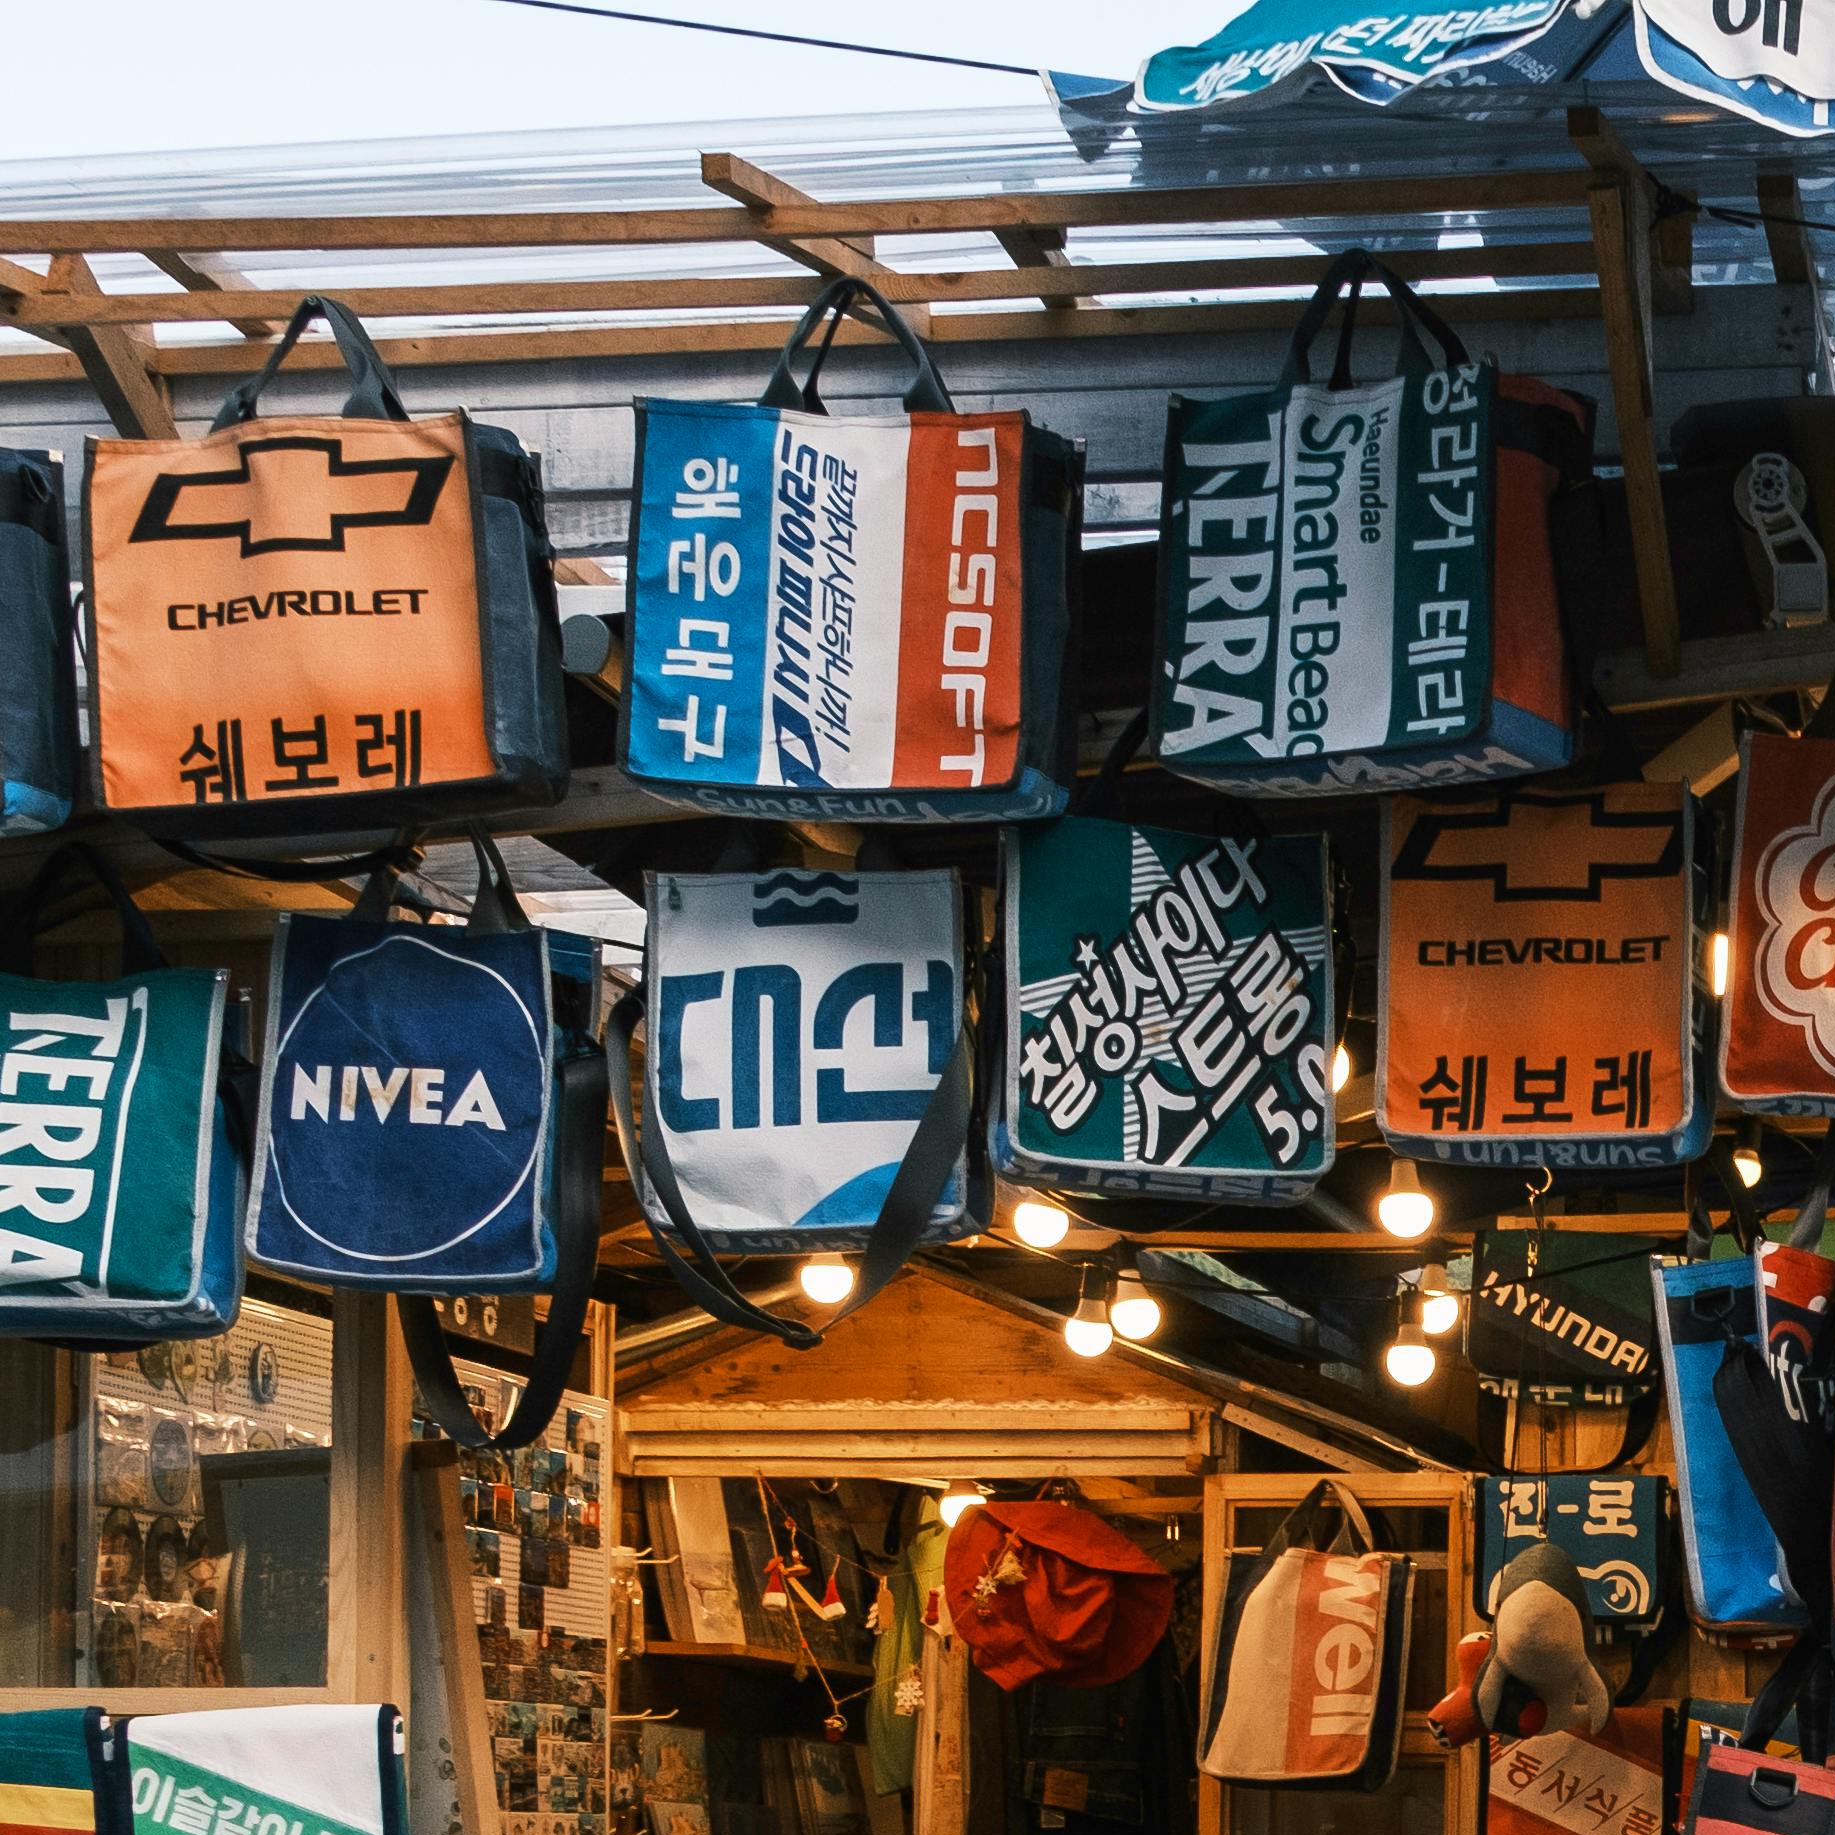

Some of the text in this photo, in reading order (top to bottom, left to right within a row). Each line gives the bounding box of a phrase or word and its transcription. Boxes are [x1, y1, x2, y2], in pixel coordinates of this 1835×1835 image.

[1358, 406, 1391, 545] Haeundae
[167, 588, 429, 632] CHEVROLET
[657, 456, 742, 763] 해운대구
[1160, 411, 1284, 758] TERRA
[179, 708, 423, 803] 쉐보레
[1417, 935, 1670, 968] CHEVROLET
[291, 1064, 508, 1132] NIVEA
[1418, 1049, 1653, 1132] 쉐보레
